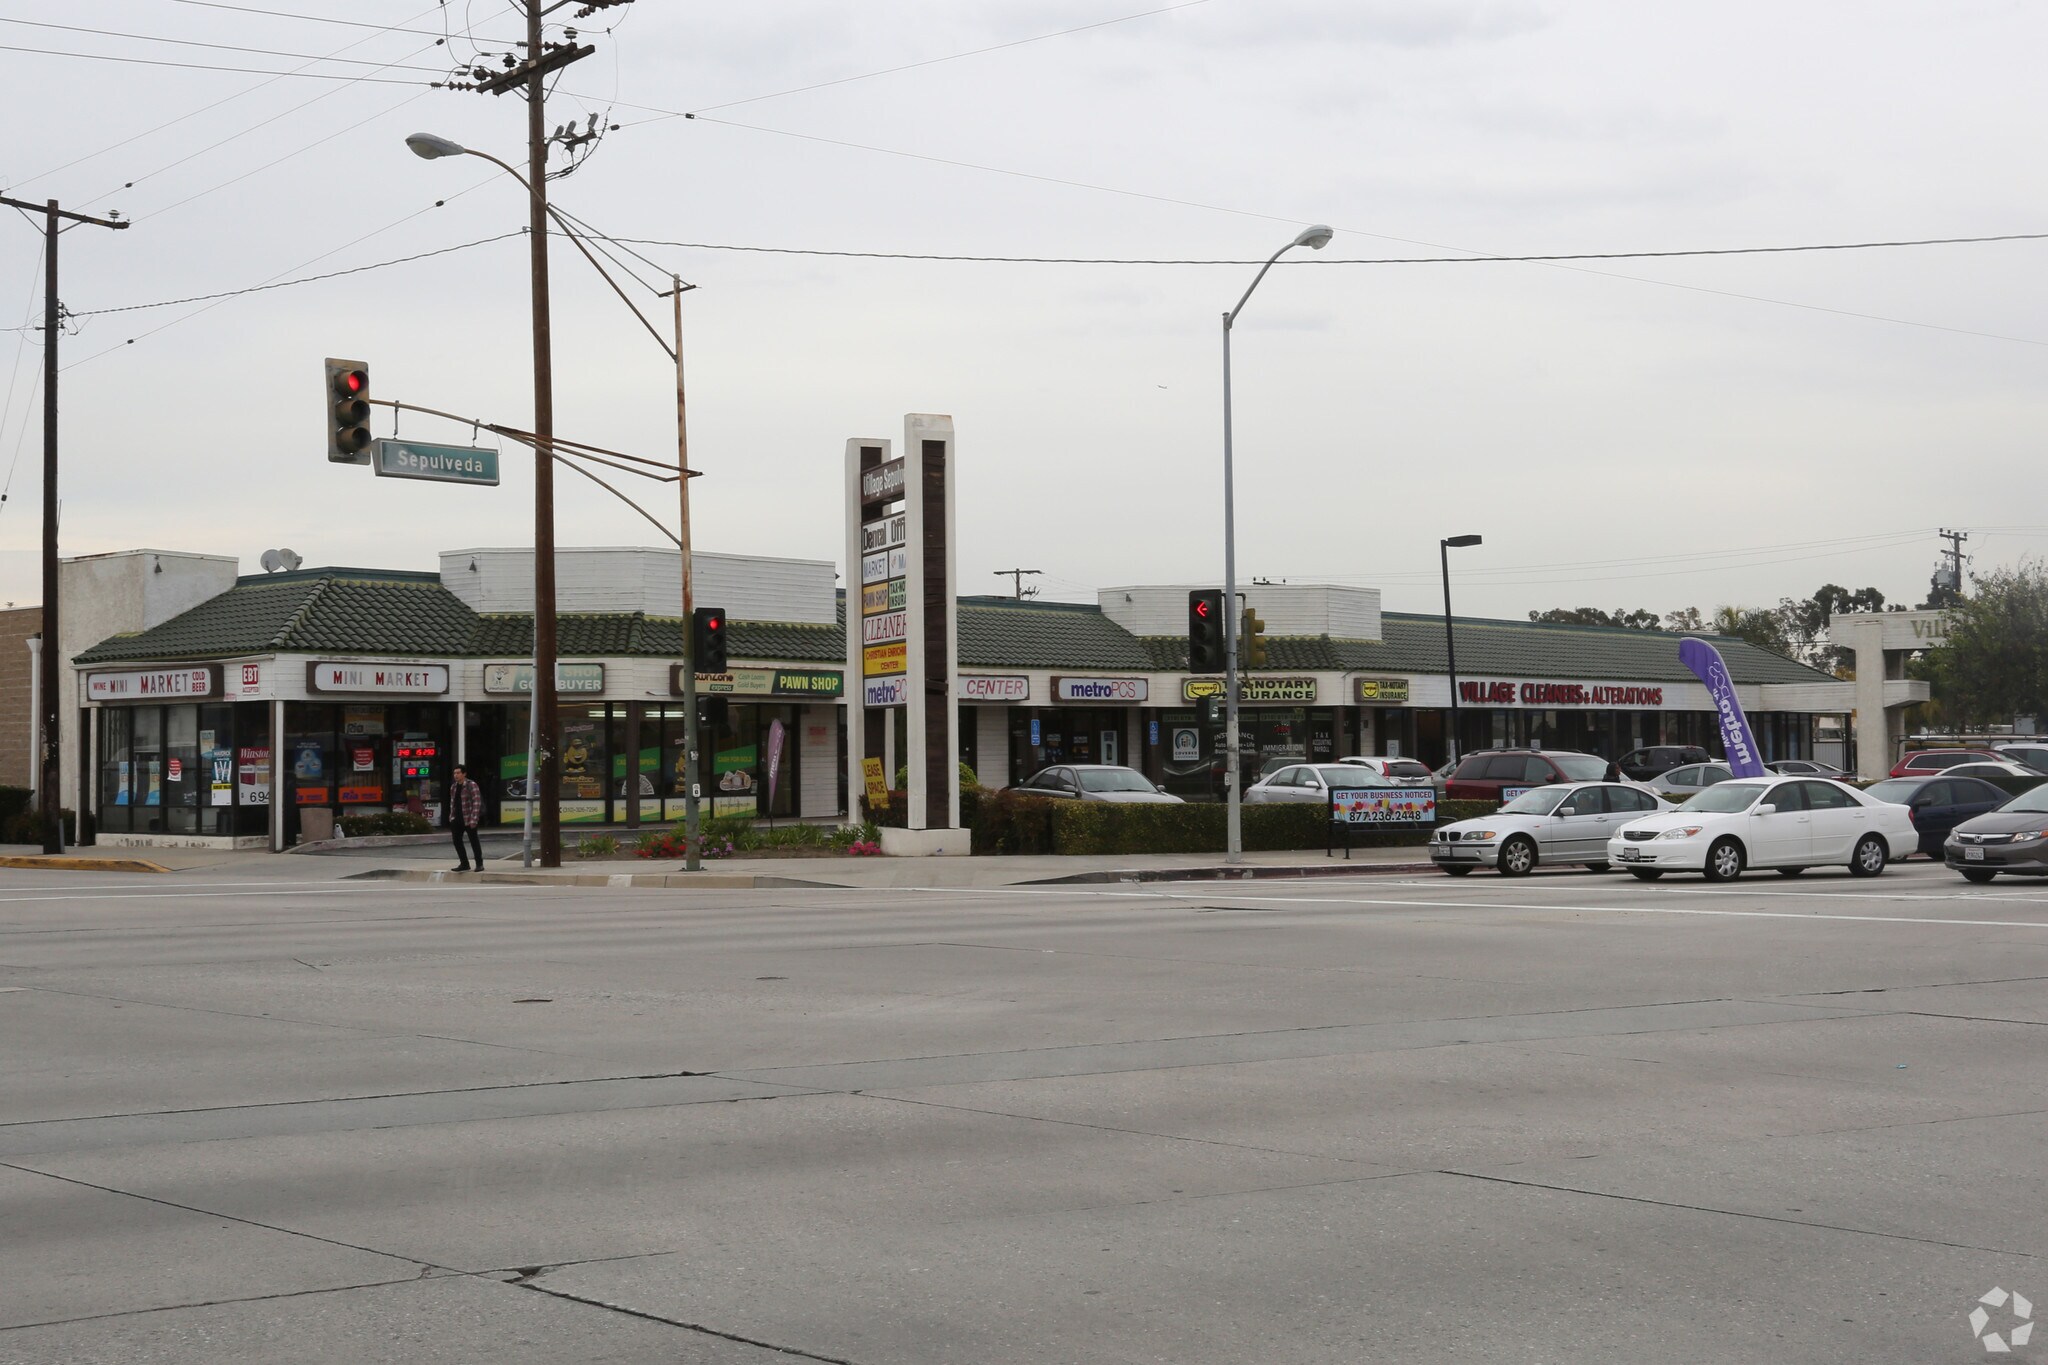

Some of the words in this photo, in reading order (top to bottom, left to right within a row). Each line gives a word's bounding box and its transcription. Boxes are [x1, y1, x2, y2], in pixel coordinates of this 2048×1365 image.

[398, 450, 484, 473] Sepulveda
[863, 472, 884, 497] Village
[863, 522, 887, 551] Dental
[864, 558, 885, 578] MARKET
[564, 667, 599, 676] SHOP
[880, 660, 898, 670] CENTER
[192, 671, 205, 681] COLD
[244, 666, 258, 682] EBT
[333, 670, 362, 685] MINI
[376, 672, 430, 686] MARKET
[93, 682, 106, 690] WINE
[110, 680, 128, 693] MINI
[140, 673, 188, 694] MARKET
[192, 682, 206, 692] BEER
[560, 680, 602, 690] BUYER
[780, 676, 808, 690] PAWN
[812, 676, 838, 690] SHOP
[966, 680, 1023, 694] CENTER
[1071, 681, 1136, 698] metroPCS
[1380, 682, 1406, 690] TAX-NOTARY
[868, 678, 907, 704] metroPC
[1380, 692, 1407, 700] INSURANCE
[1459, 681, 1516, 703] VILLAGE
[1521, 682, 1584, 704] CLEANERS
[1584, 692, 1590, 704] &
[1591, 686, 1663, 706] ALTERATIONS
[342, 790, 359, 800] Ria
[1349, 810, 1421, 821] 877.236.2448
